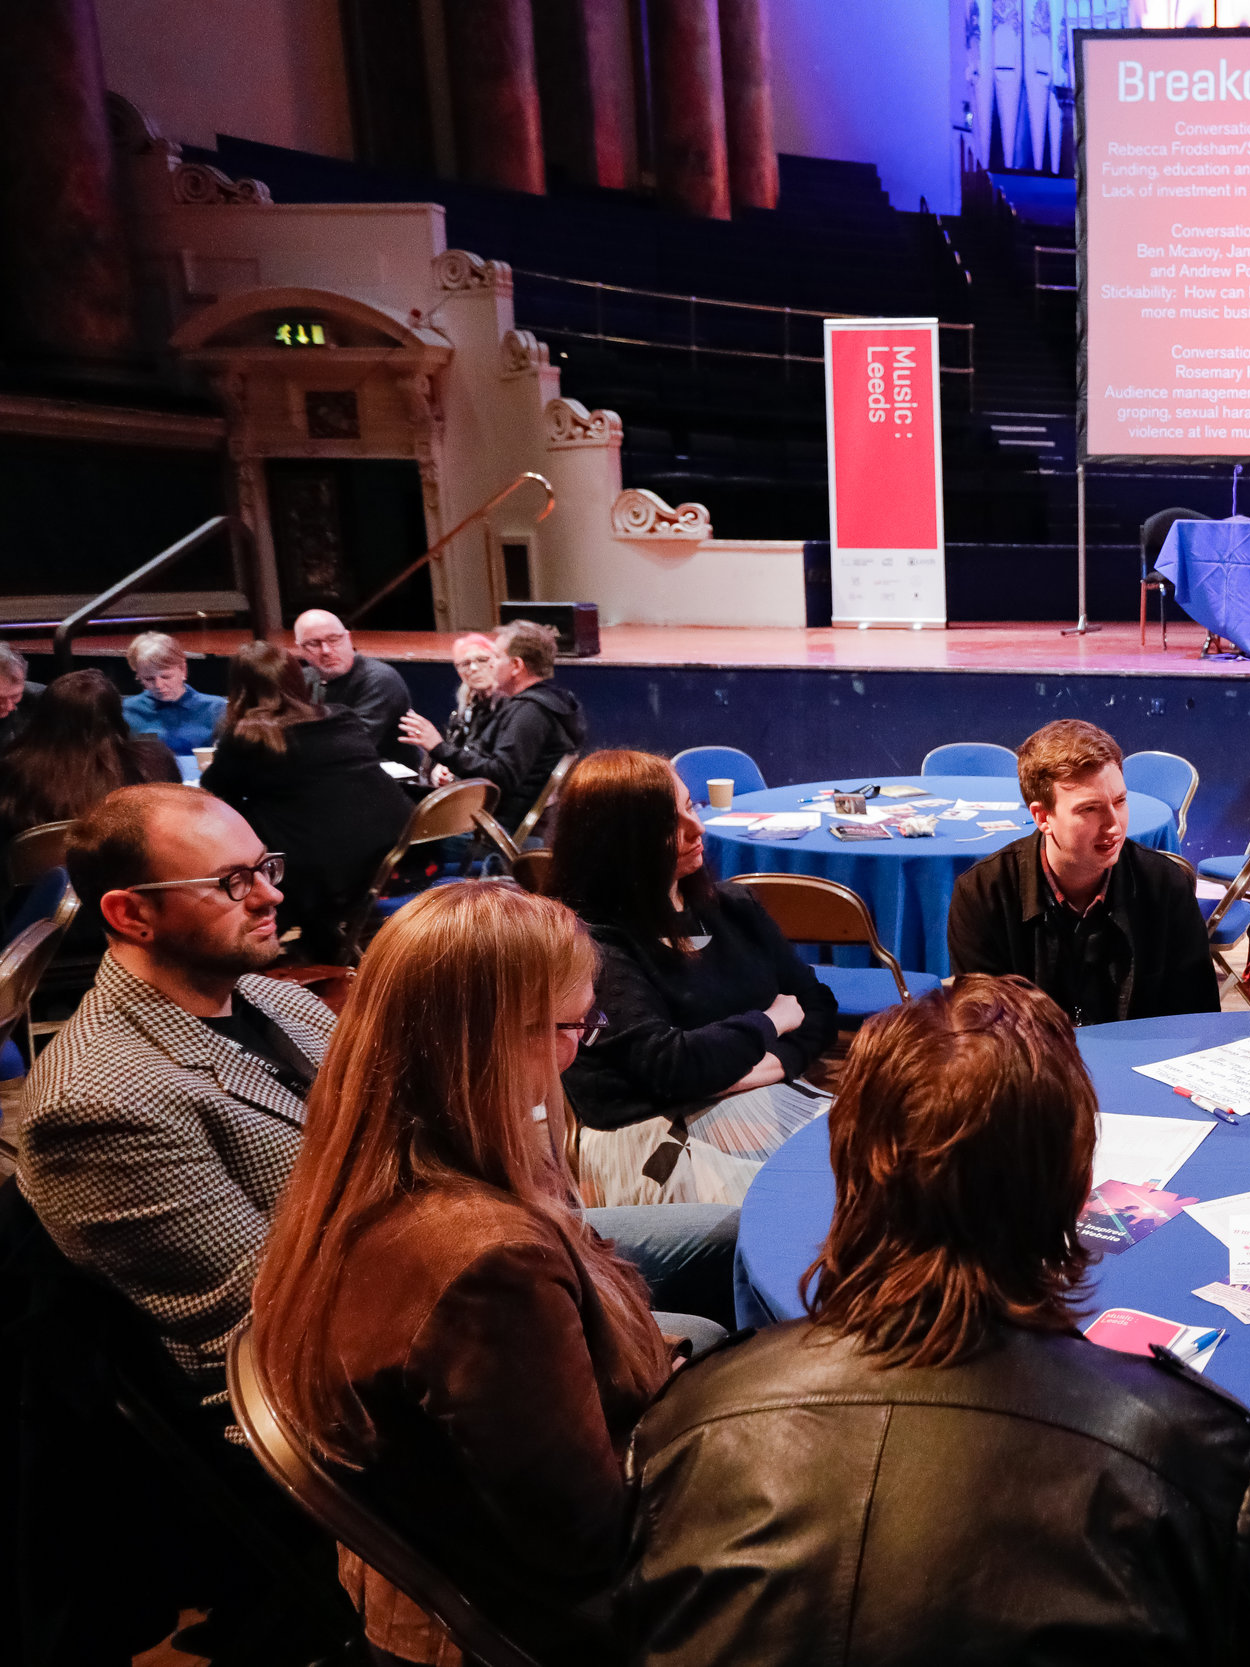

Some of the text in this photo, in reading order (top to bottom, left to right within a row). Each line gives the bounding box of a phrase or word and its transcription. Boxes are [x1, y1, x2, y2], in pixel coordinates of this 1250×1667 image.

[1108, 141, 1167, 156] Rebecca
[1163, 162, 1230, 176] education
[1102, 183, 1135, 198] Lack
[1138, 182, 1153, 197] of
[1157, 183, 1231, 197] investment
[1235, 183, 1247, 197] in
[1136, 243, 1165, 258] Ben
[1150, 264, 1176, 278] and
[1179, 264, 1231, 278] Andrew
[1100, 284, 1177, 302] Stickability:
[1184, 285, 1217, 298] How
[1220, 287, 1245, 299] can
[1141, 307, 1176, 319] more
[1180, 305, 1220, 319] music
[1176, 364, 1243, 382] Rosemary
[867, 346, 891, 423] Leeds
[892, 346, 919, 425] Music
[1104, 385, 1169, 399] Audience
[1117, 406, 1172, 422] groping,
[1176, 405, 1219, 419] sexual
[1128, 425, 1184, 438] violence
[1188, 427, 1201, 438] at
[1204, 425, 1228, 438] live
